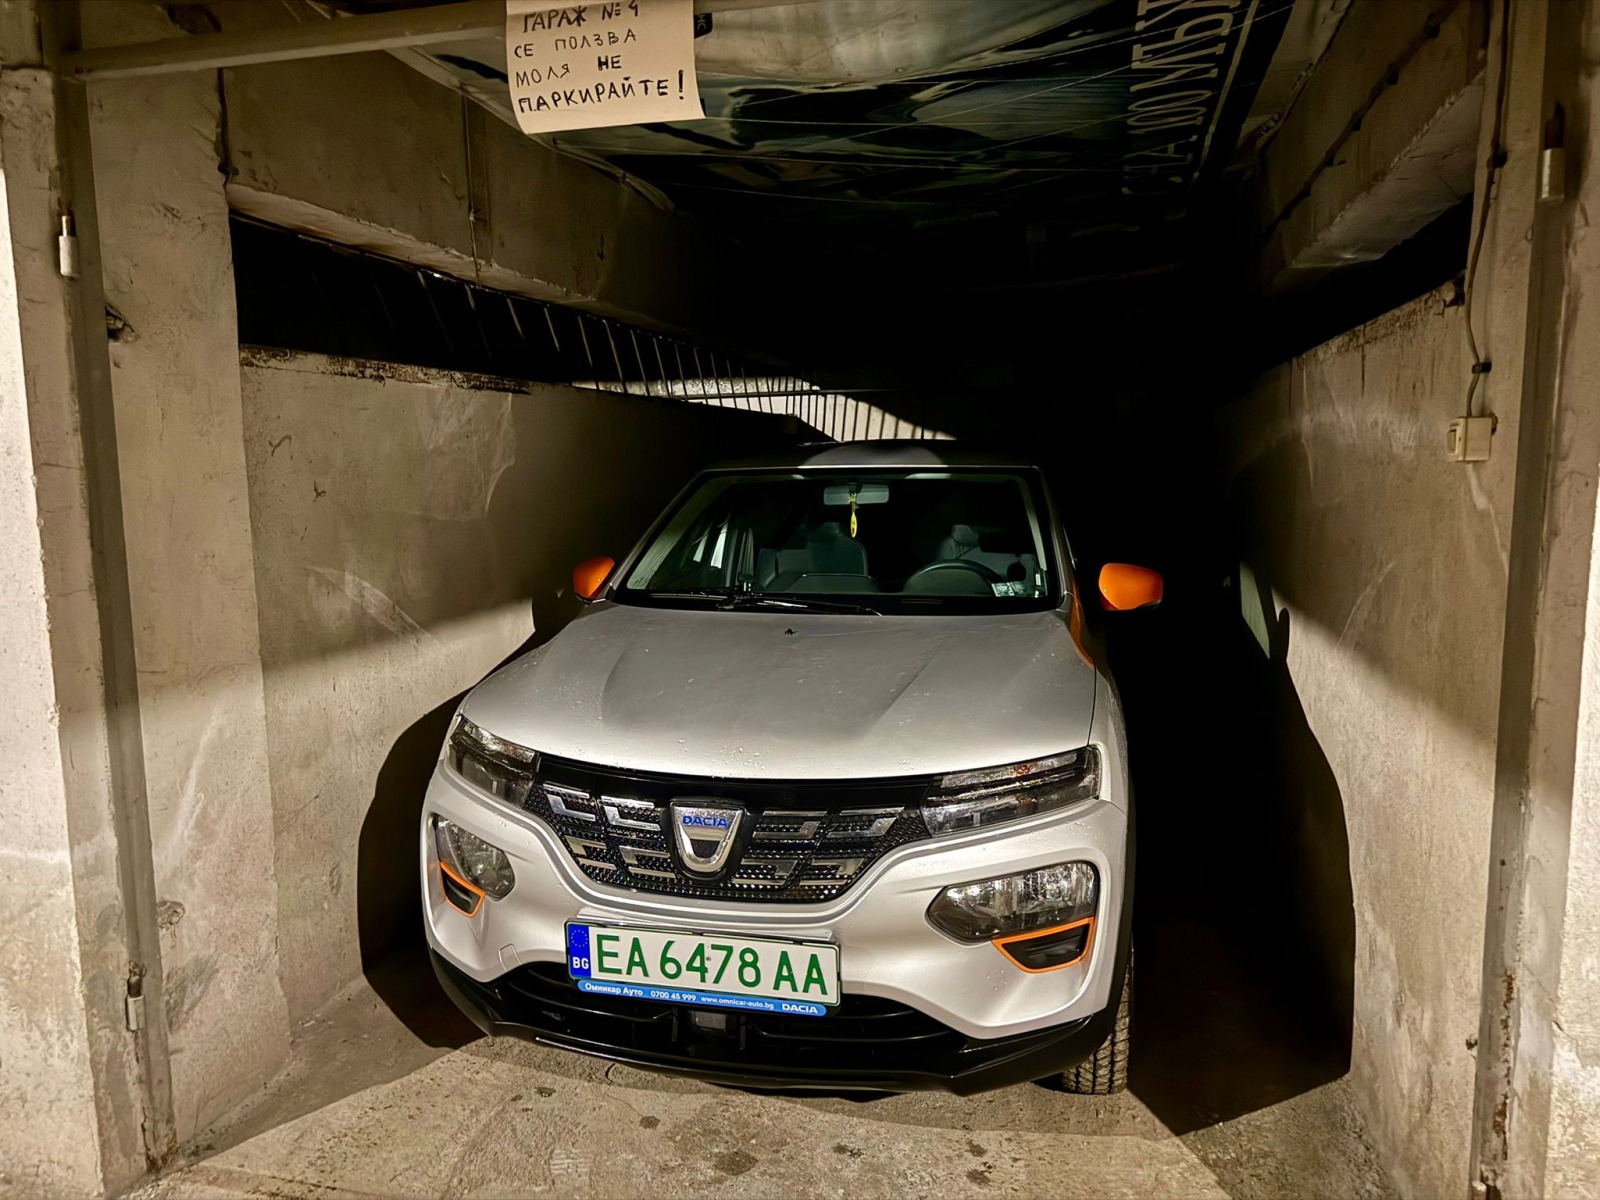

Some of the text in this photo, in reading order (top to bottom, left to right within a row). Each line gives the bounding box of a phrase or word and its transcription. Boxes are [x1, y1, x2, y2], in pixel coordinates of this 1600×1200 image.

[523, 5, 588, 33] ГАРАЖ
[627, 0, 640, 17] 4
[514, 28, 637, 59] СЕ ПОЛЗВА
[516, 55, 622, 89] МОЛЯ НЕ
[518, 69, 684, 114] ПАРКИРАЙТЕ!
[1126, 90, 1213, 134] 100
[682, 815, 728, 828] DACIA
[572, 956, 590, 970] BG
[596, 933, 828, 996] EA 6478 AA
[584, 982, 819, 1015] Омникар Ауто 0700 45 999 www.omnicar-auto.bg DACIA
